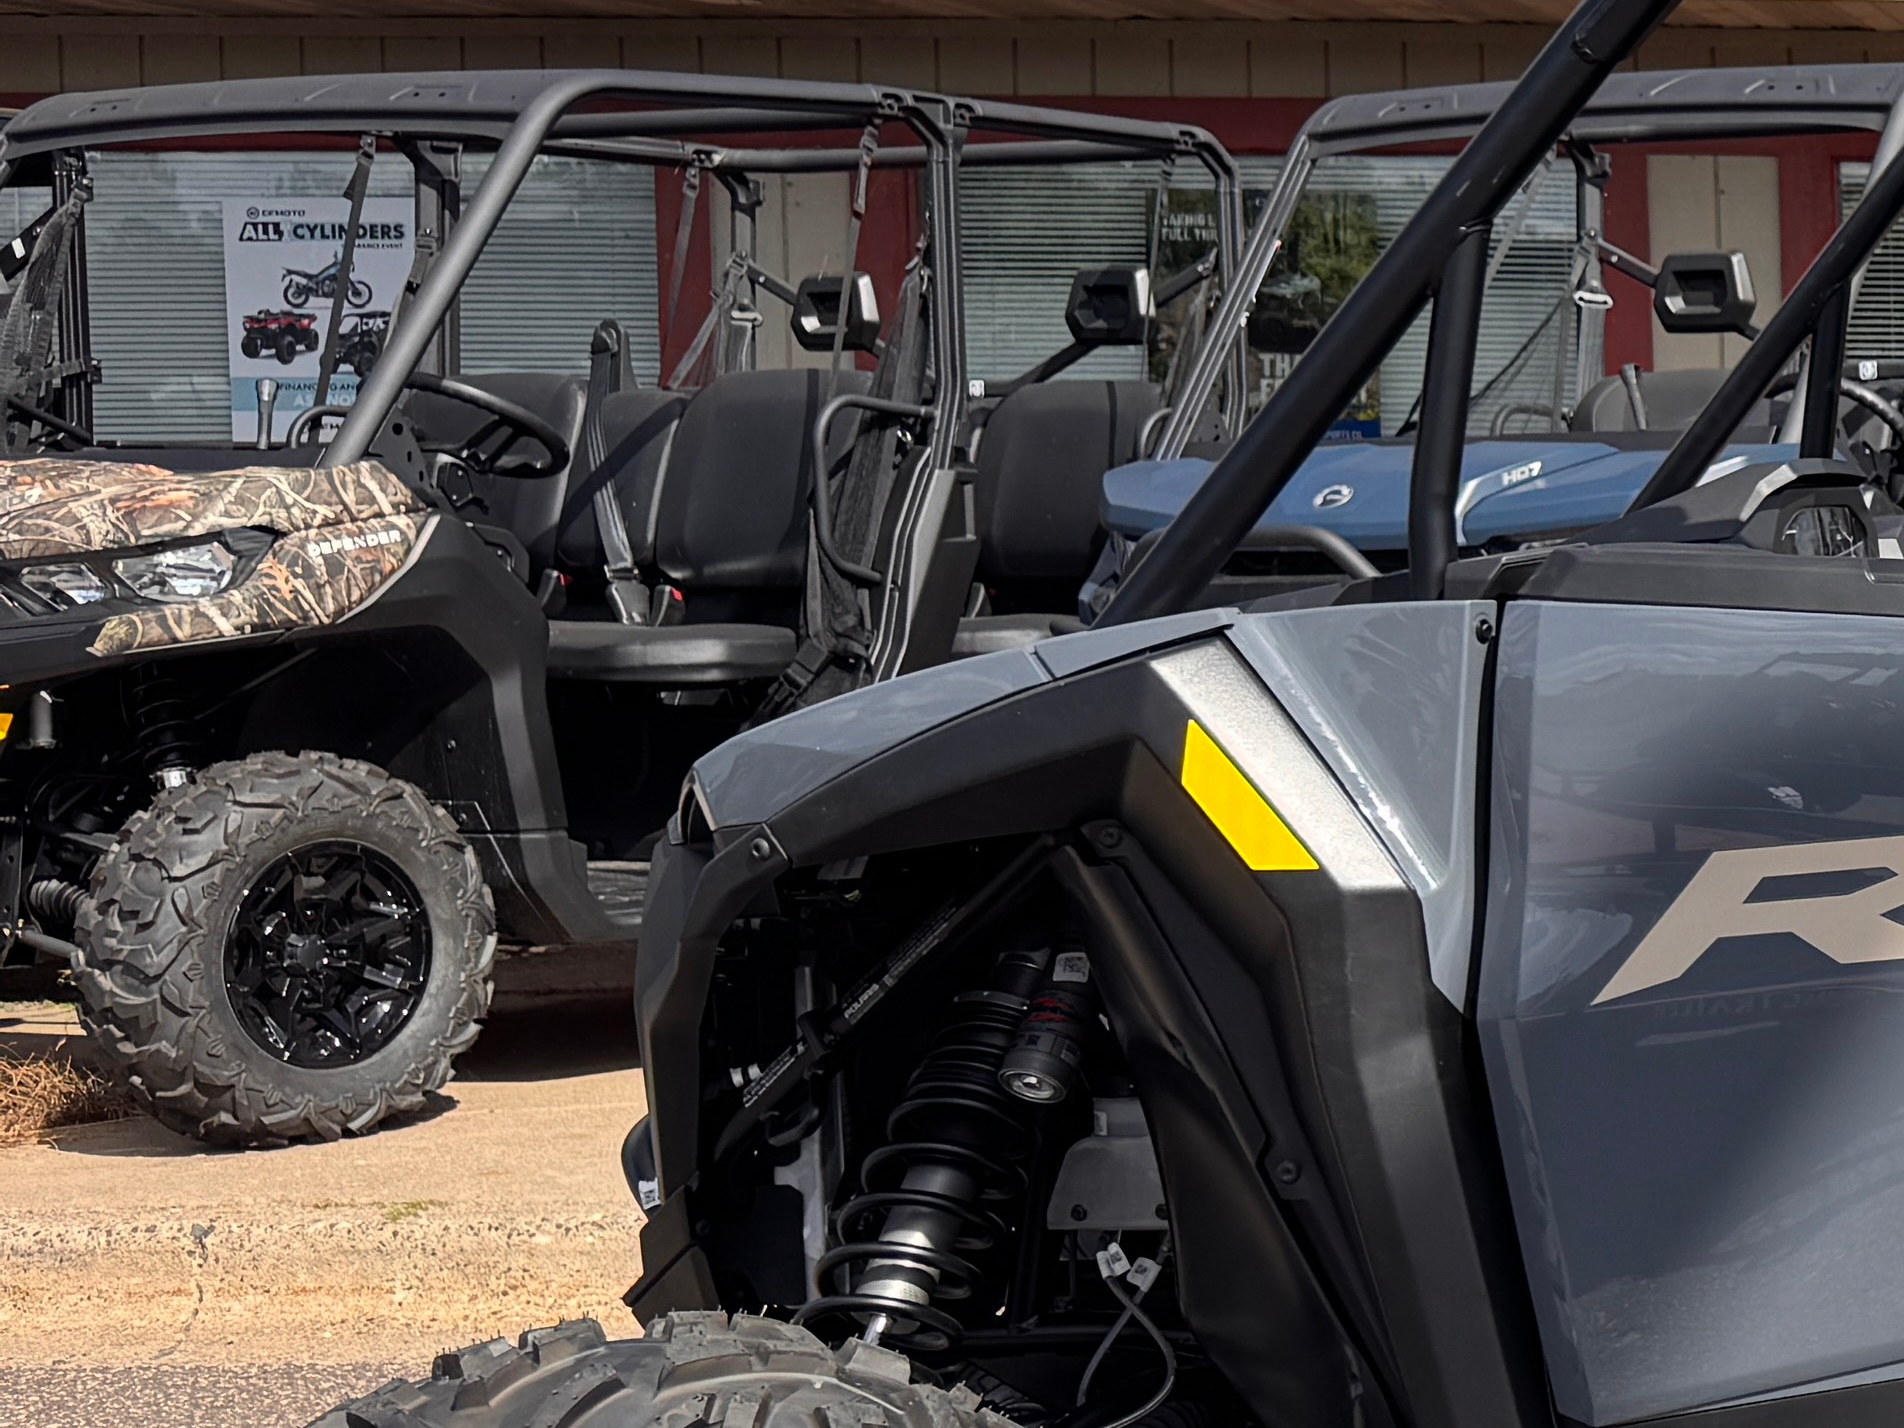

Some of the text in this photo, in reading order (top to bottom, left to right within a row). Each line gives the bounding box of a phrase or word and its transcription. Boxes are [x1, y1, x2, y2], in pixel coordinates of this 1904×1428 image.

[241, 222, 282, 241] ALL
[1258, 353, 1303, 377] TH
[1502, 460, 1542, 486] HD7
[306, 529, 401, 558] DEFENDER
